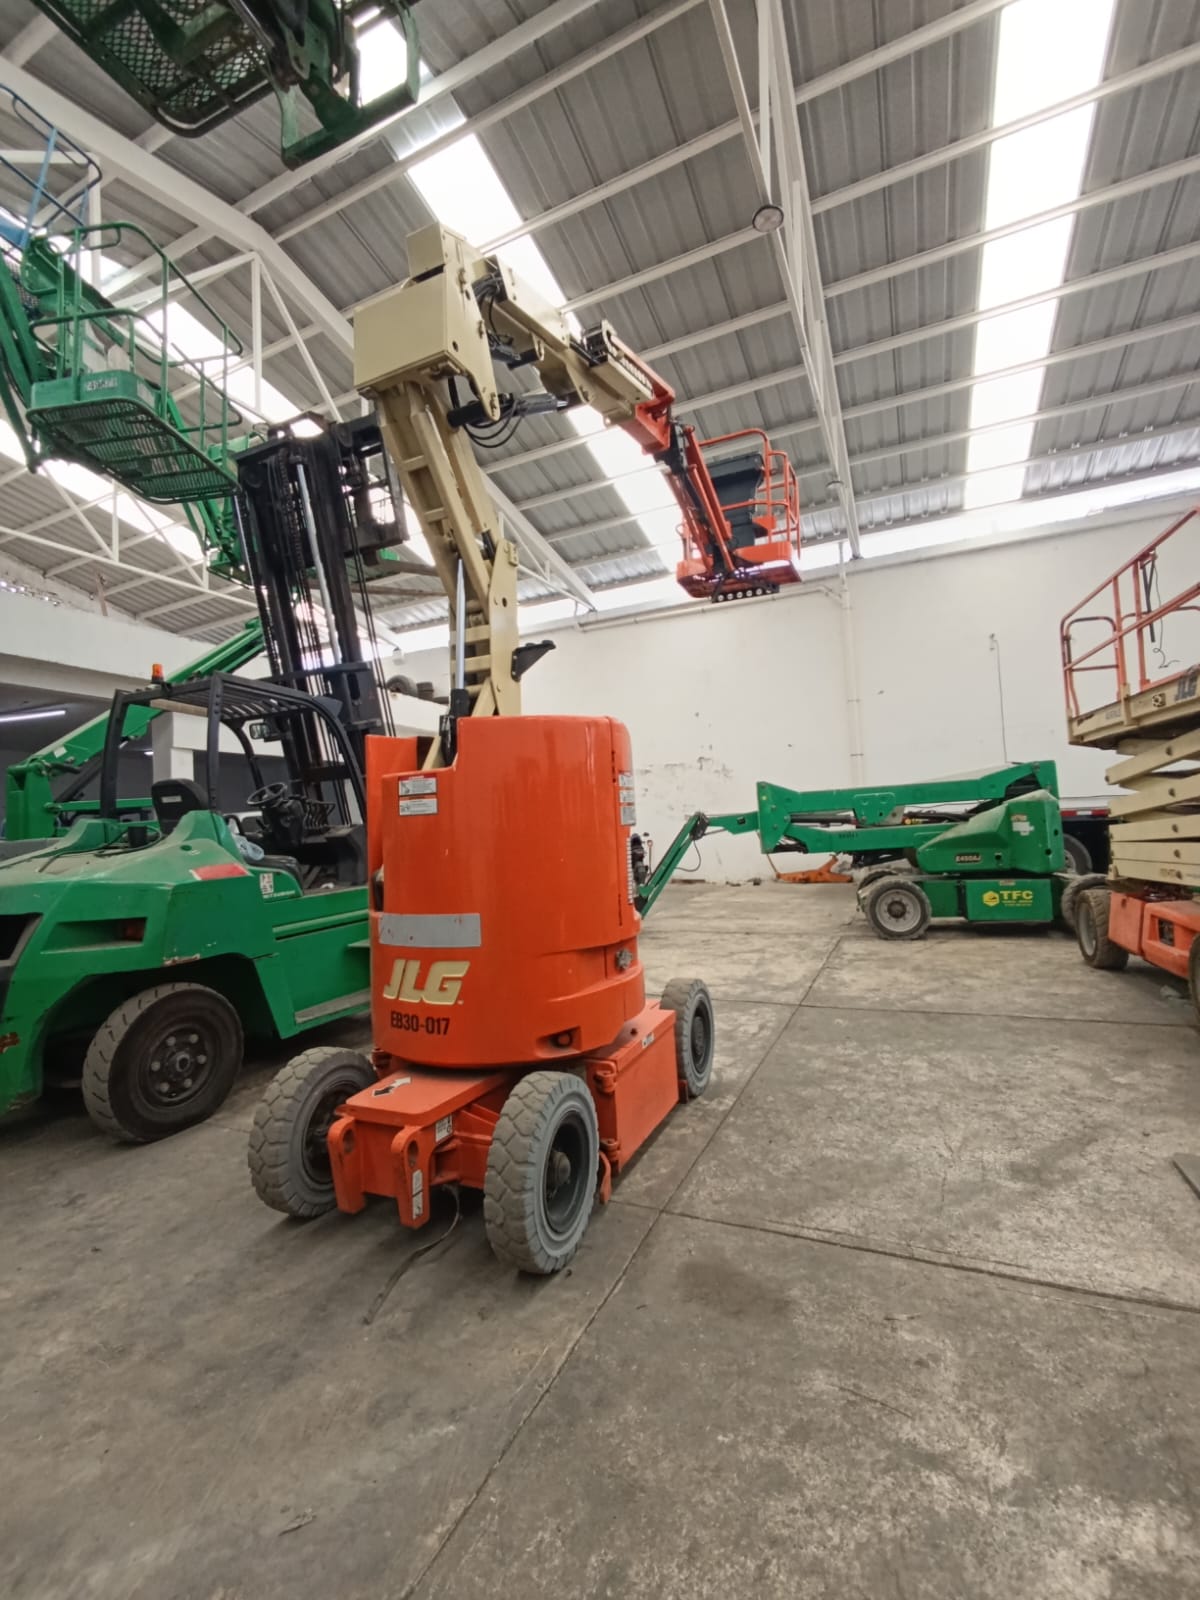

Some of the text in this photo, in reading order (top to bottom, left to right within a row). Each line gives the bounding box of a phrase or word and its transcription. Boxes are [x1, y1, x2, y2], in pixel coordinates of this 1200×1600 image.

[1000, 890, 1033, 900] TFC
[383, 959, 470, 1005] JLG
[391, 1010, 450, 1036] EB30-017
